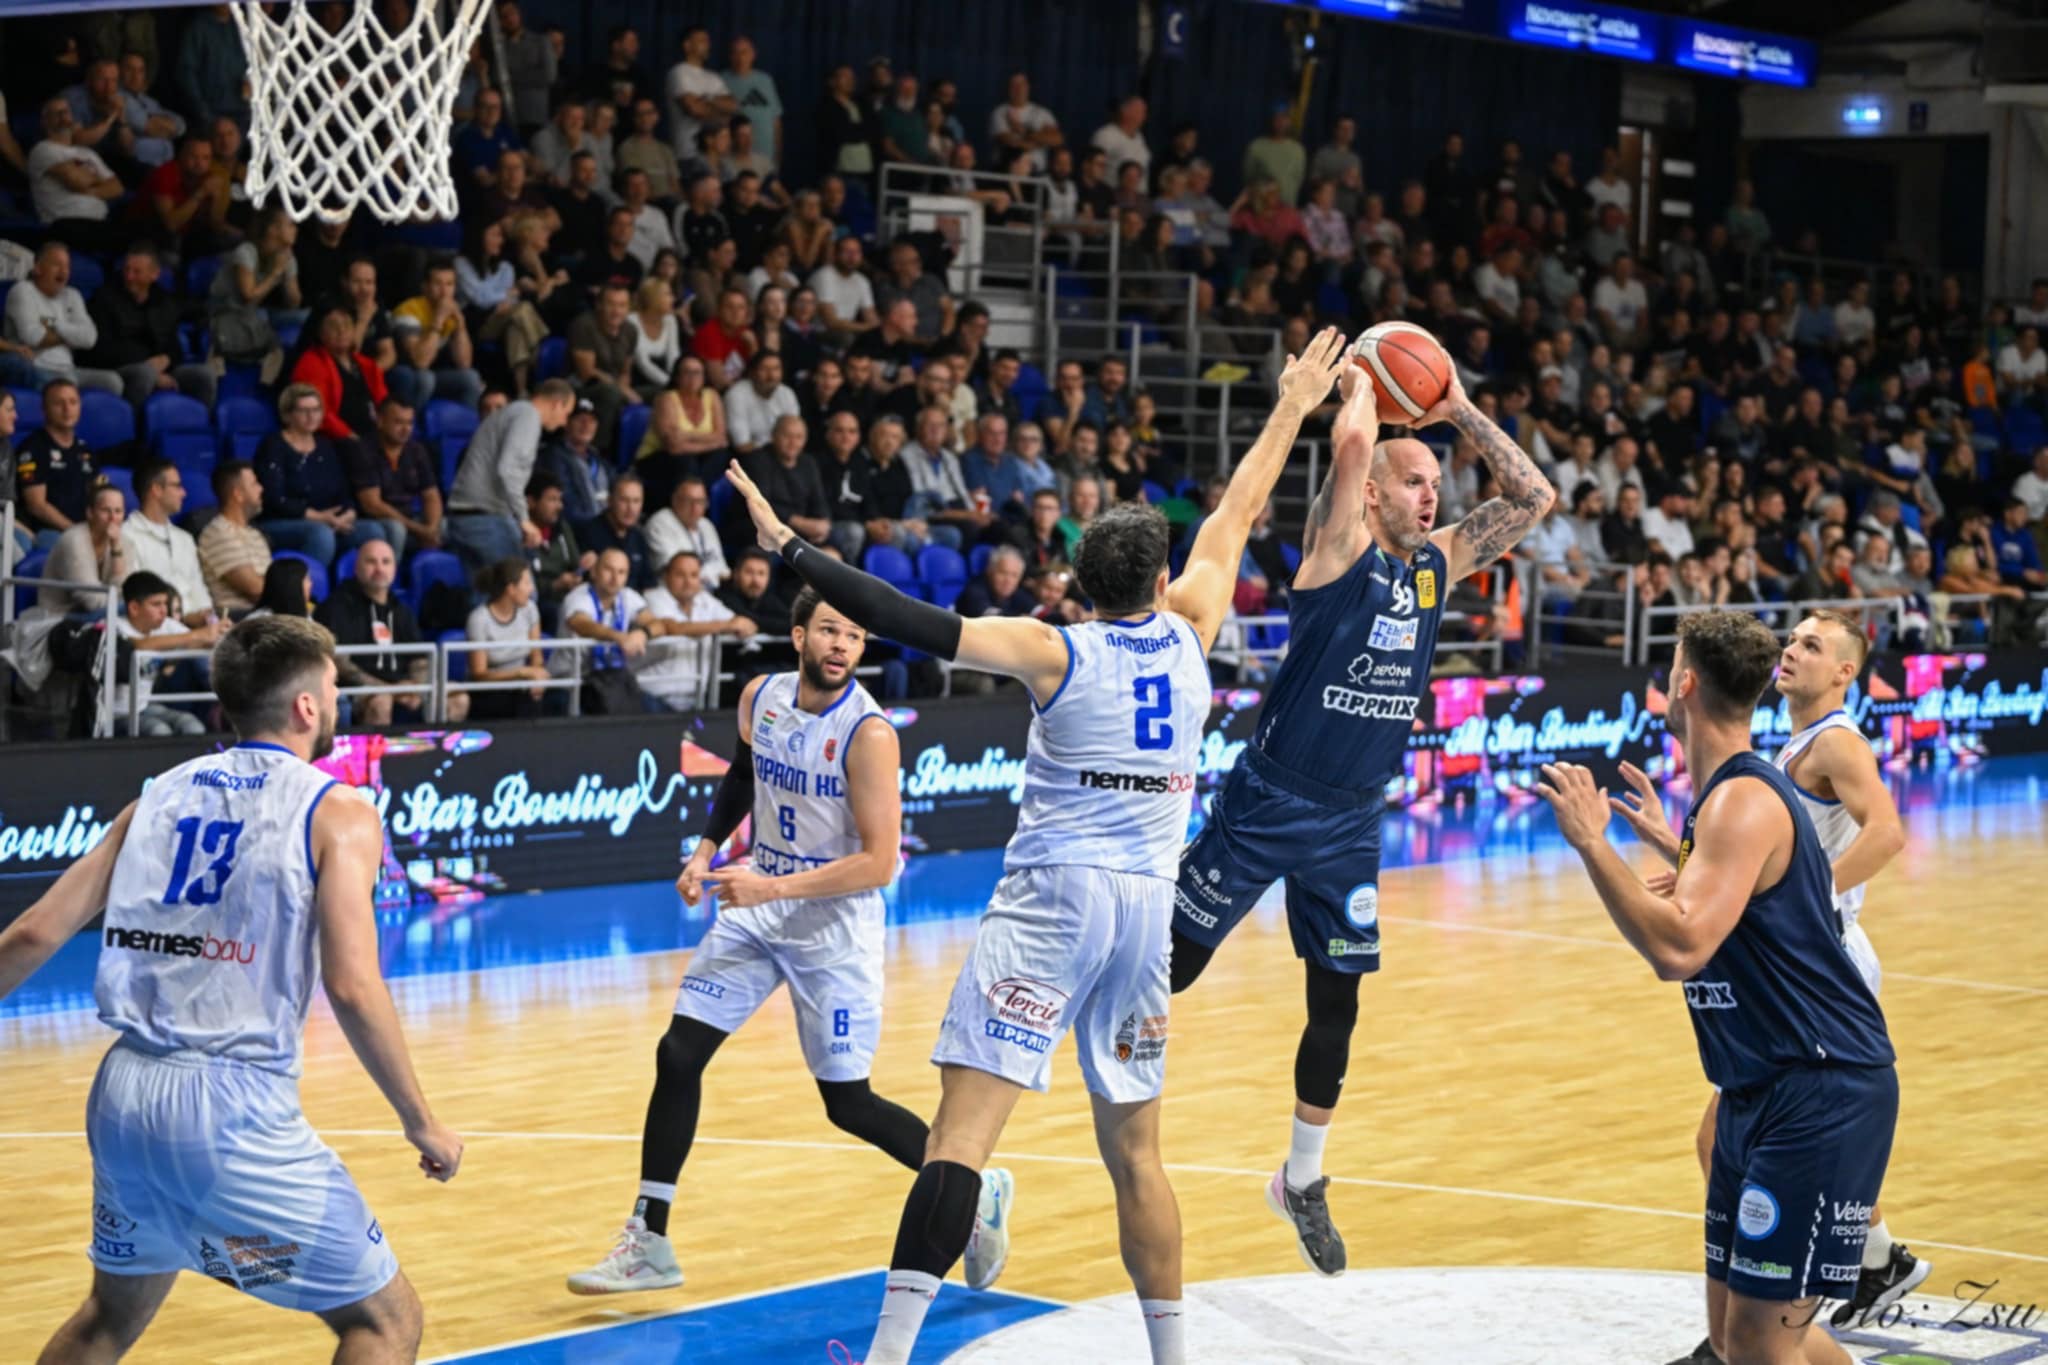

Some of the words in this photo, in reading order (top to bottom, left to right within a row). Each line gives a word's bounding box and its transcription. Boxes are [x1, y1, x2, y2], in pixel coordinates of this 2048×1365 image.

[1389, 579, 1415, 616] 99
[1133, 673, 1173, 750] 2
[392, 781, 478, 836] Star
[483, 748, 686, 837] Bowling
[752, 751, 808, 797] OPRON
[779, 806, 796, 842] 6
[162, 816, 244, 906] 13
[104, 926, 256, 965] nemesbau
[834, 1009, 849, 1037] 6
